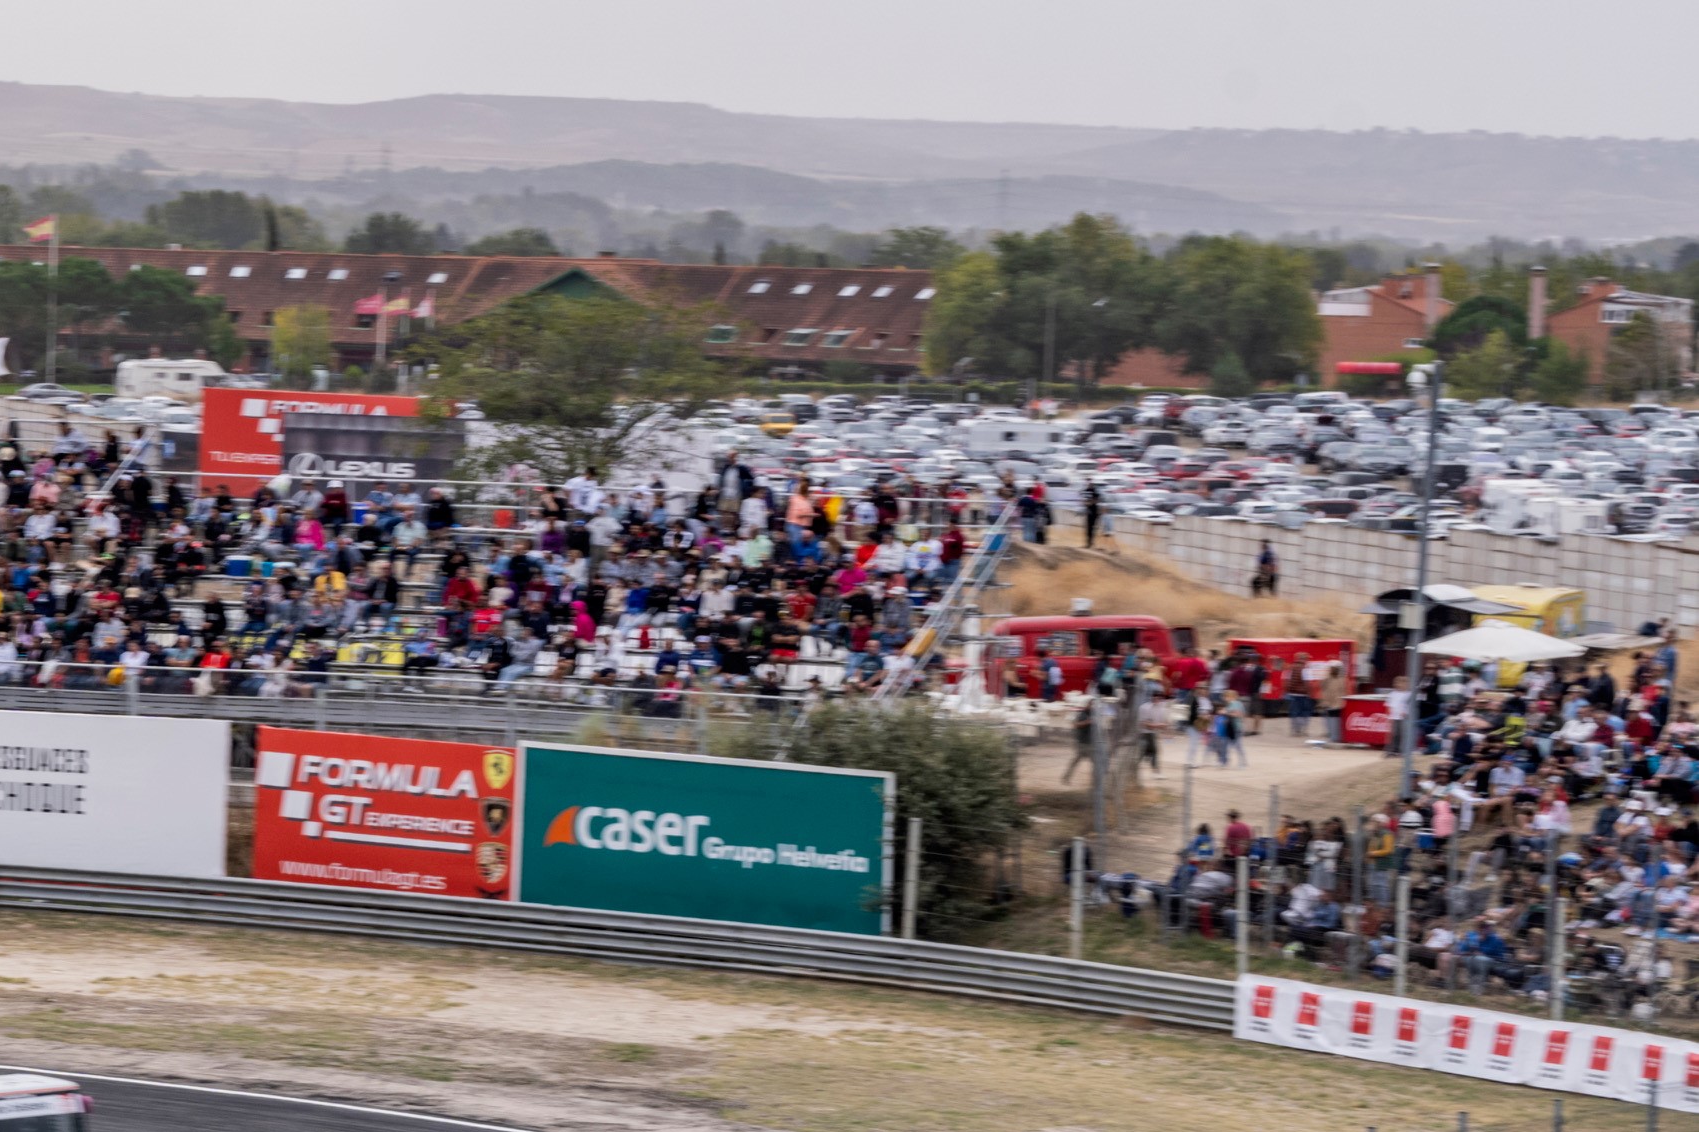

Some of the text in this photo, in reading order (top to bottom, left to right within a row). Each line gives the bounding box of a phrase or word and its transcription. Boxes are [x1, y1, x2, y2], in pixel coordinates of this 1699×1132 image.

[324, 460, 416, 478] LEXUS
[296, 755, 479, 798] FORMULA
[318, 794, 476, 836] GT EXPERIENCE
[576, 806, 710, 857] caser
[703, 836, 776, 868] Grupo
